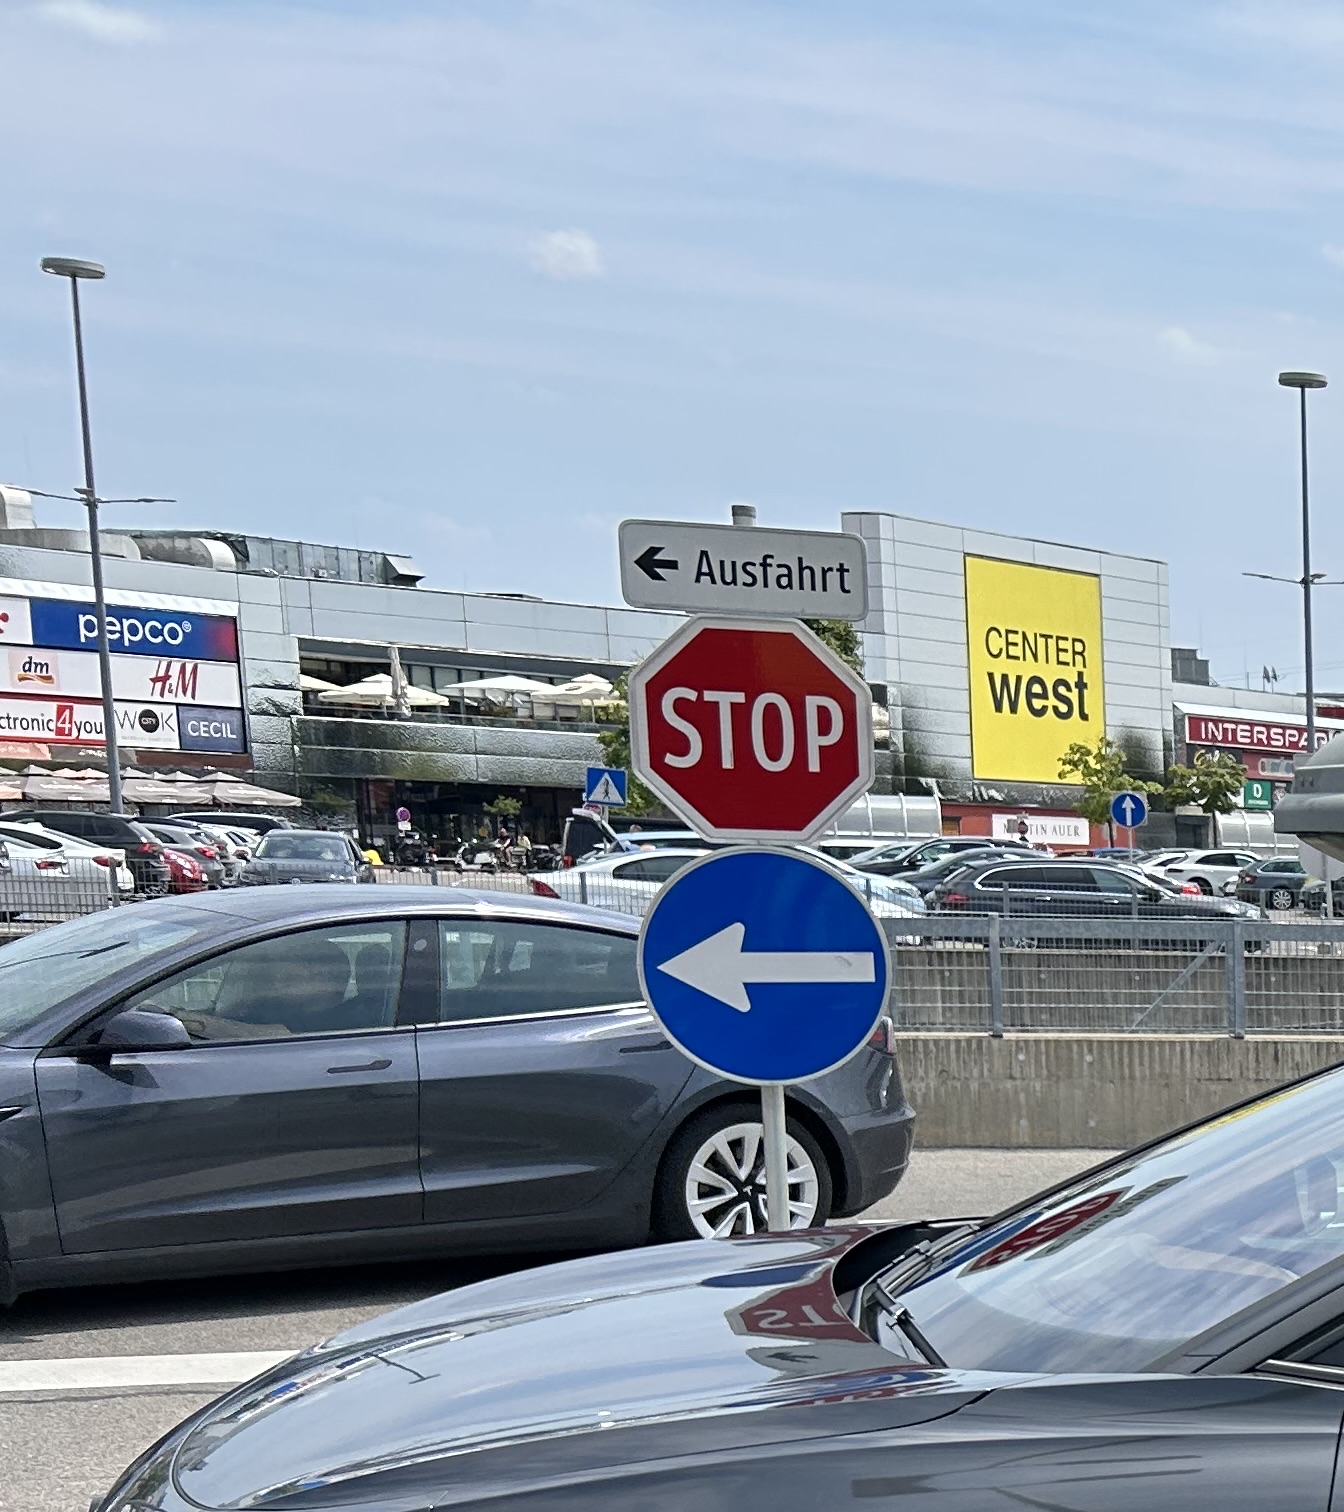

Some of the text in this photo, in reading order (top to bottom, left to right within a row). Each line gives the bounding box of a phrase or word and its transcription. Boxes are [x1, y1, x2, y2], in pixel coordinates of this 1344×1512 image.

[694, 549, 851, 594] Ausfahrt
[22, 656, 49, 674] dm
[985, 626, 1087, 668] CENTER
[149, 660, 199, 700] H&M
[987, 670, 1089, 722] west
[187, 720, 237, 739] CECIL
[661, 687, 844, 772] STOP
[1051, 824, 1080, 837] AUER
